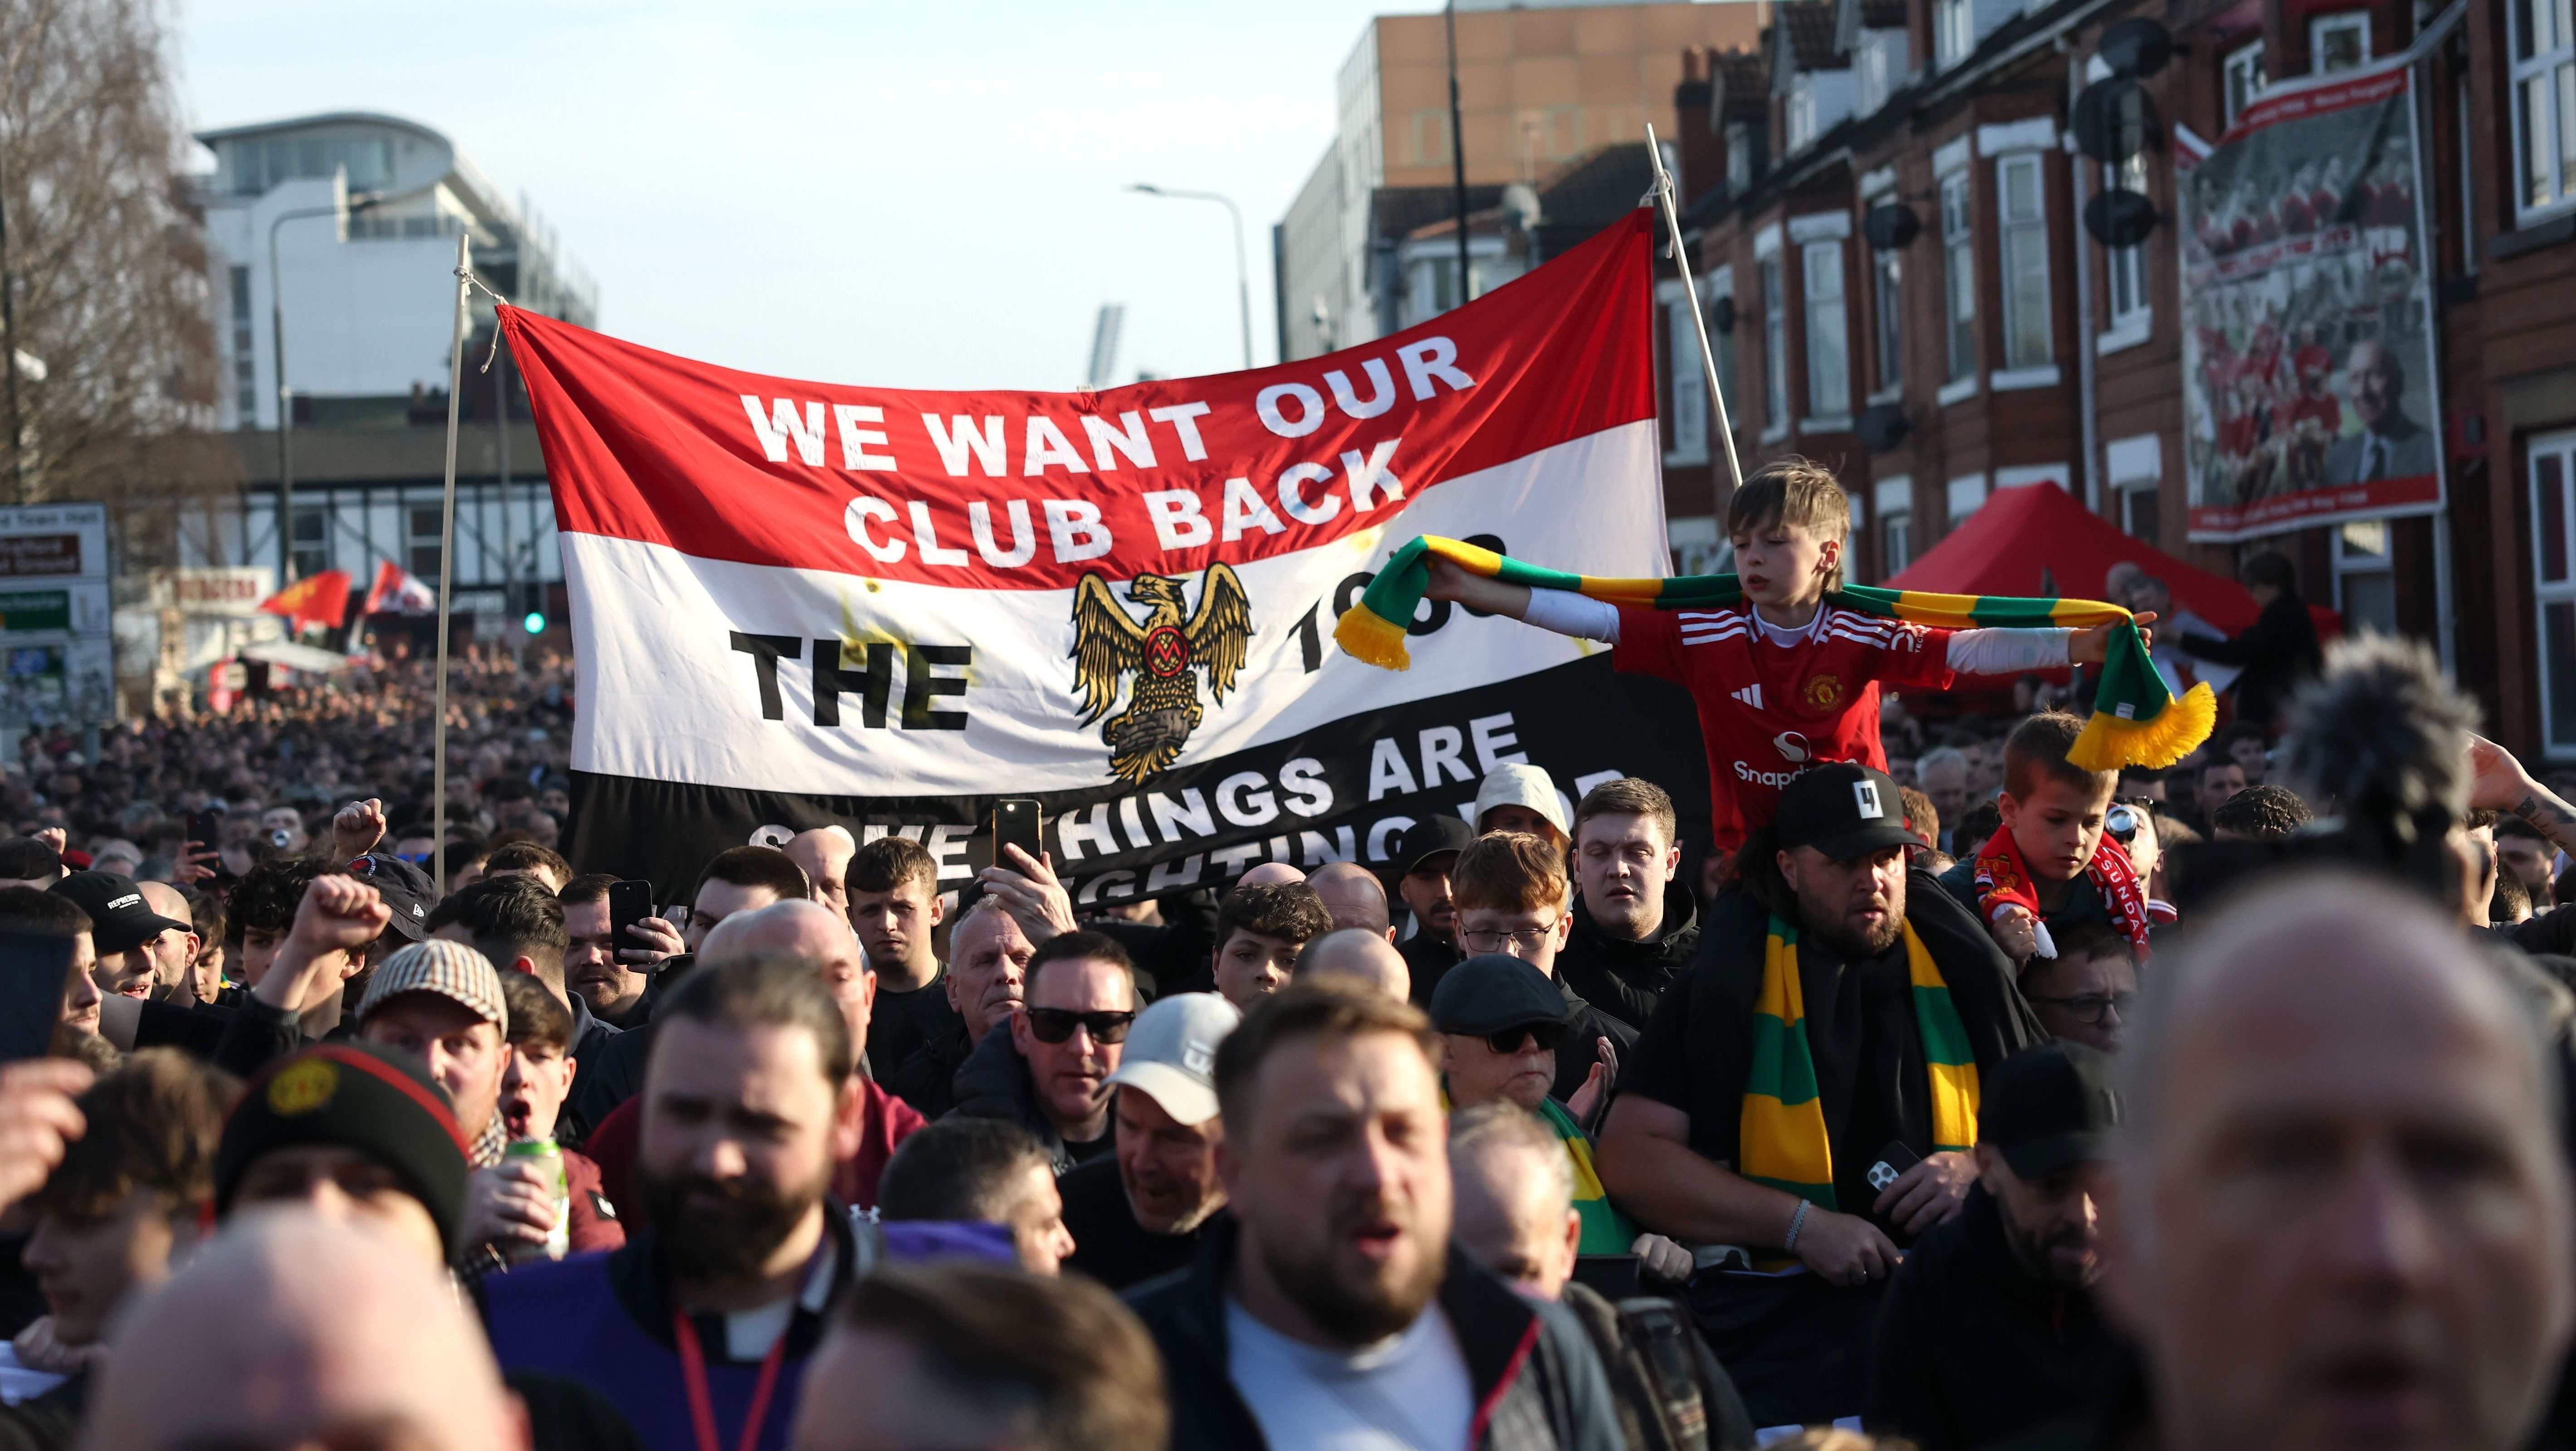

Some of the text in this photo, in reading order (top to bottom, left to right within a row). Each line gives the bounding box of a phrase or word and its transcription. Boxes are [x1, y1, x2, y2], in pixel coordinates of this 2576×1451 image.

[739, 336, 1476, 477] WE WANT OUR
[844, 438, 1406, 568] CLUB BACK
[729, 534, 1506, 731] THE 19
[1043, 757, 1334, 860] HINGS
[1367, 711, 1529, 802] ARE
[107, 893, 141, 910] REPRESENT
[1057, 815, 1418, 905] GHTING
[2101, 859, 2146, 945] SUNDAY
